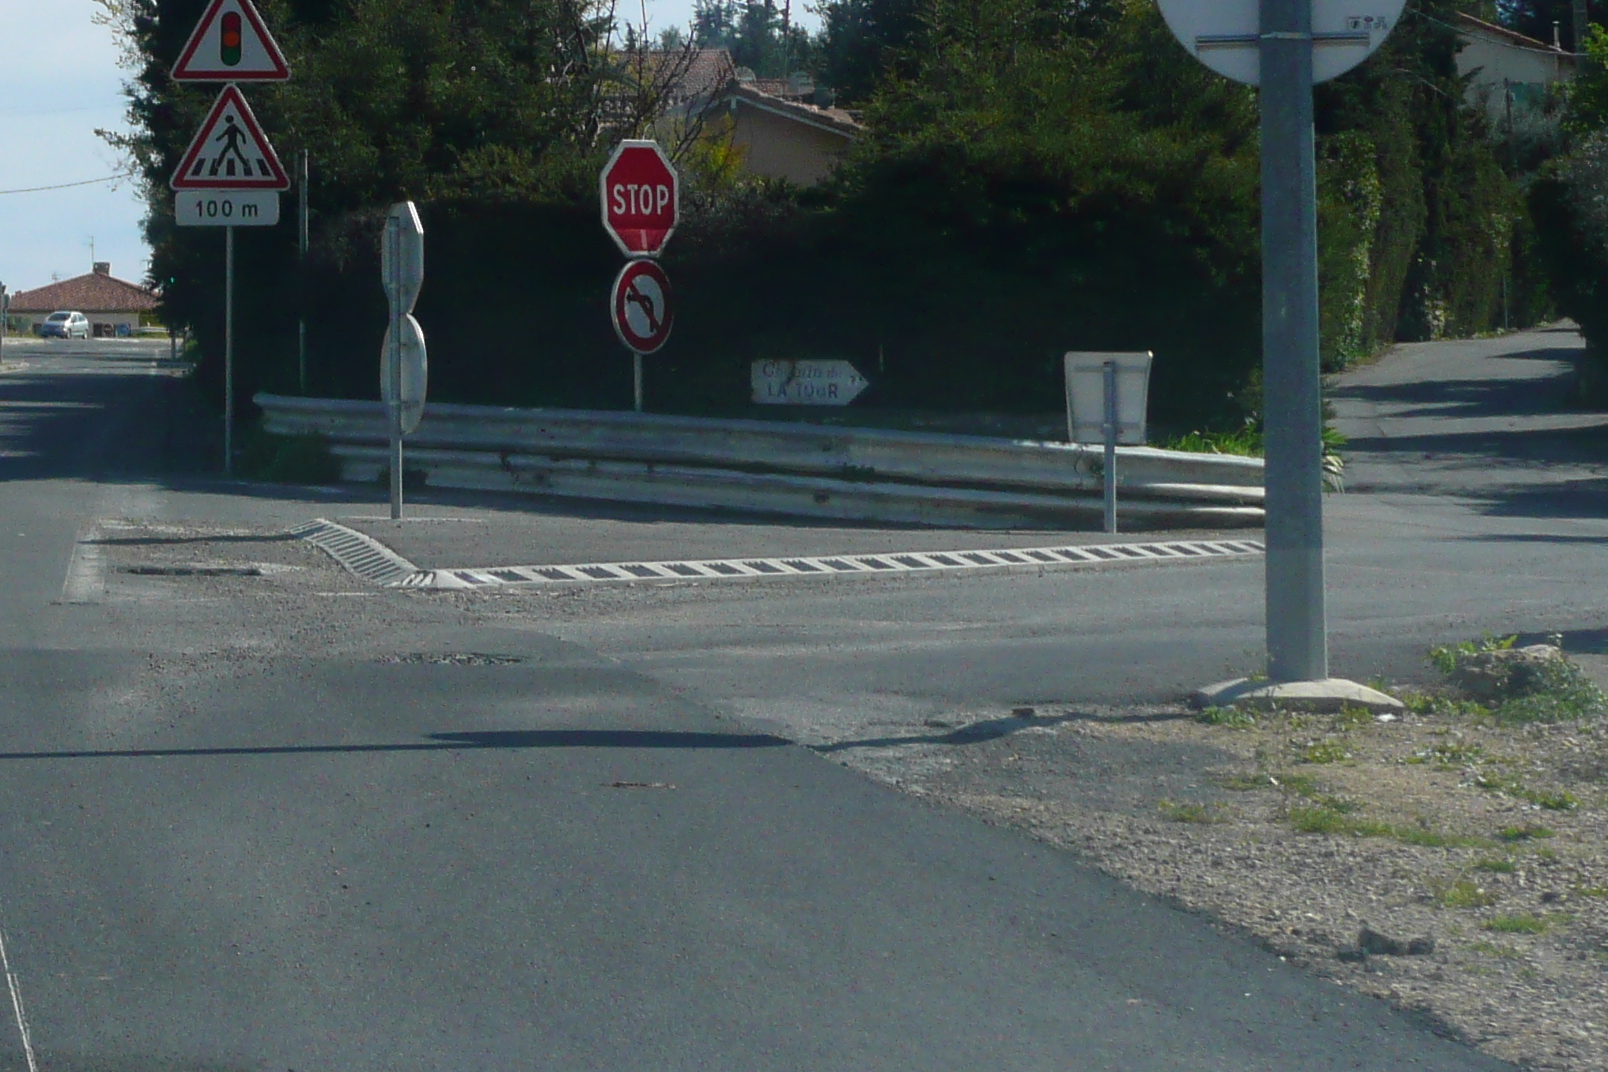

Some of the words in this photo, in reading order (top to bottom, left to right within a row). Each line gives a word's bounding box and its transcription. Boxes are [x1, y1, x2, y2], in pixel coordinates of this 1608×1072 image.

[195, 200, 233, 218] 100
[242, 203, 259, 218] m
[613, 184, 669, 215] STOP
